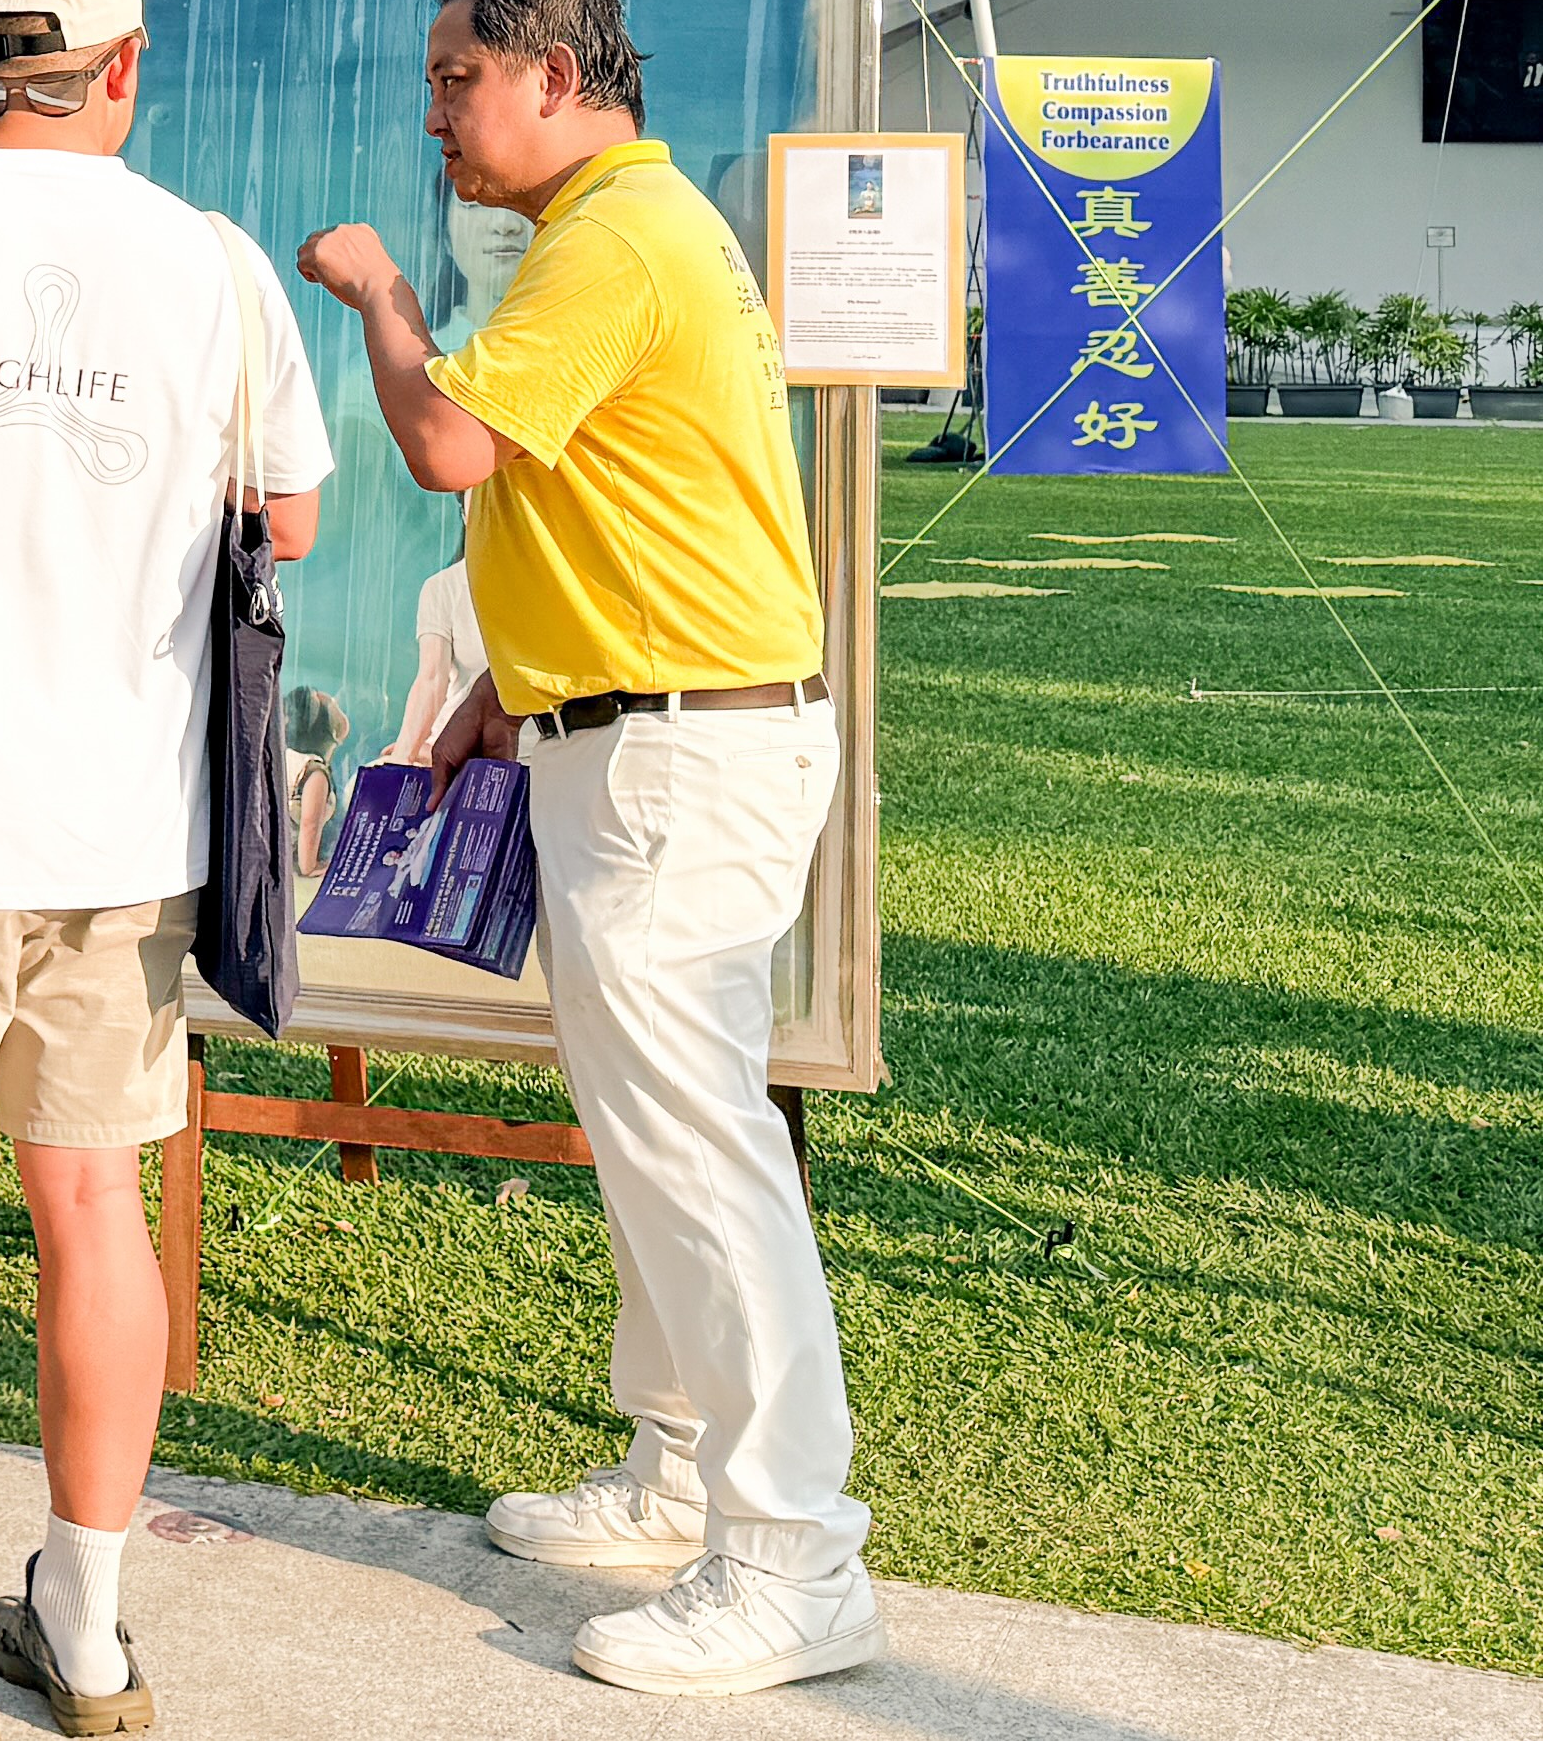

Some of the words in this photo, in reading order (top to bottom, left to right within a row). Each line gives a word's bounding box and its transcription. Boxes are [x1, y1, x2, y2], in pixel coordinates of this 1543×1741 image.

[1041, 72, 1169, 93] Truthfulness
[1042, 101, 1168, 126] Compassion
[1042, 130, 1169, 150] Forbearance
[1070, 186, 1158, 449] 真善忍好
